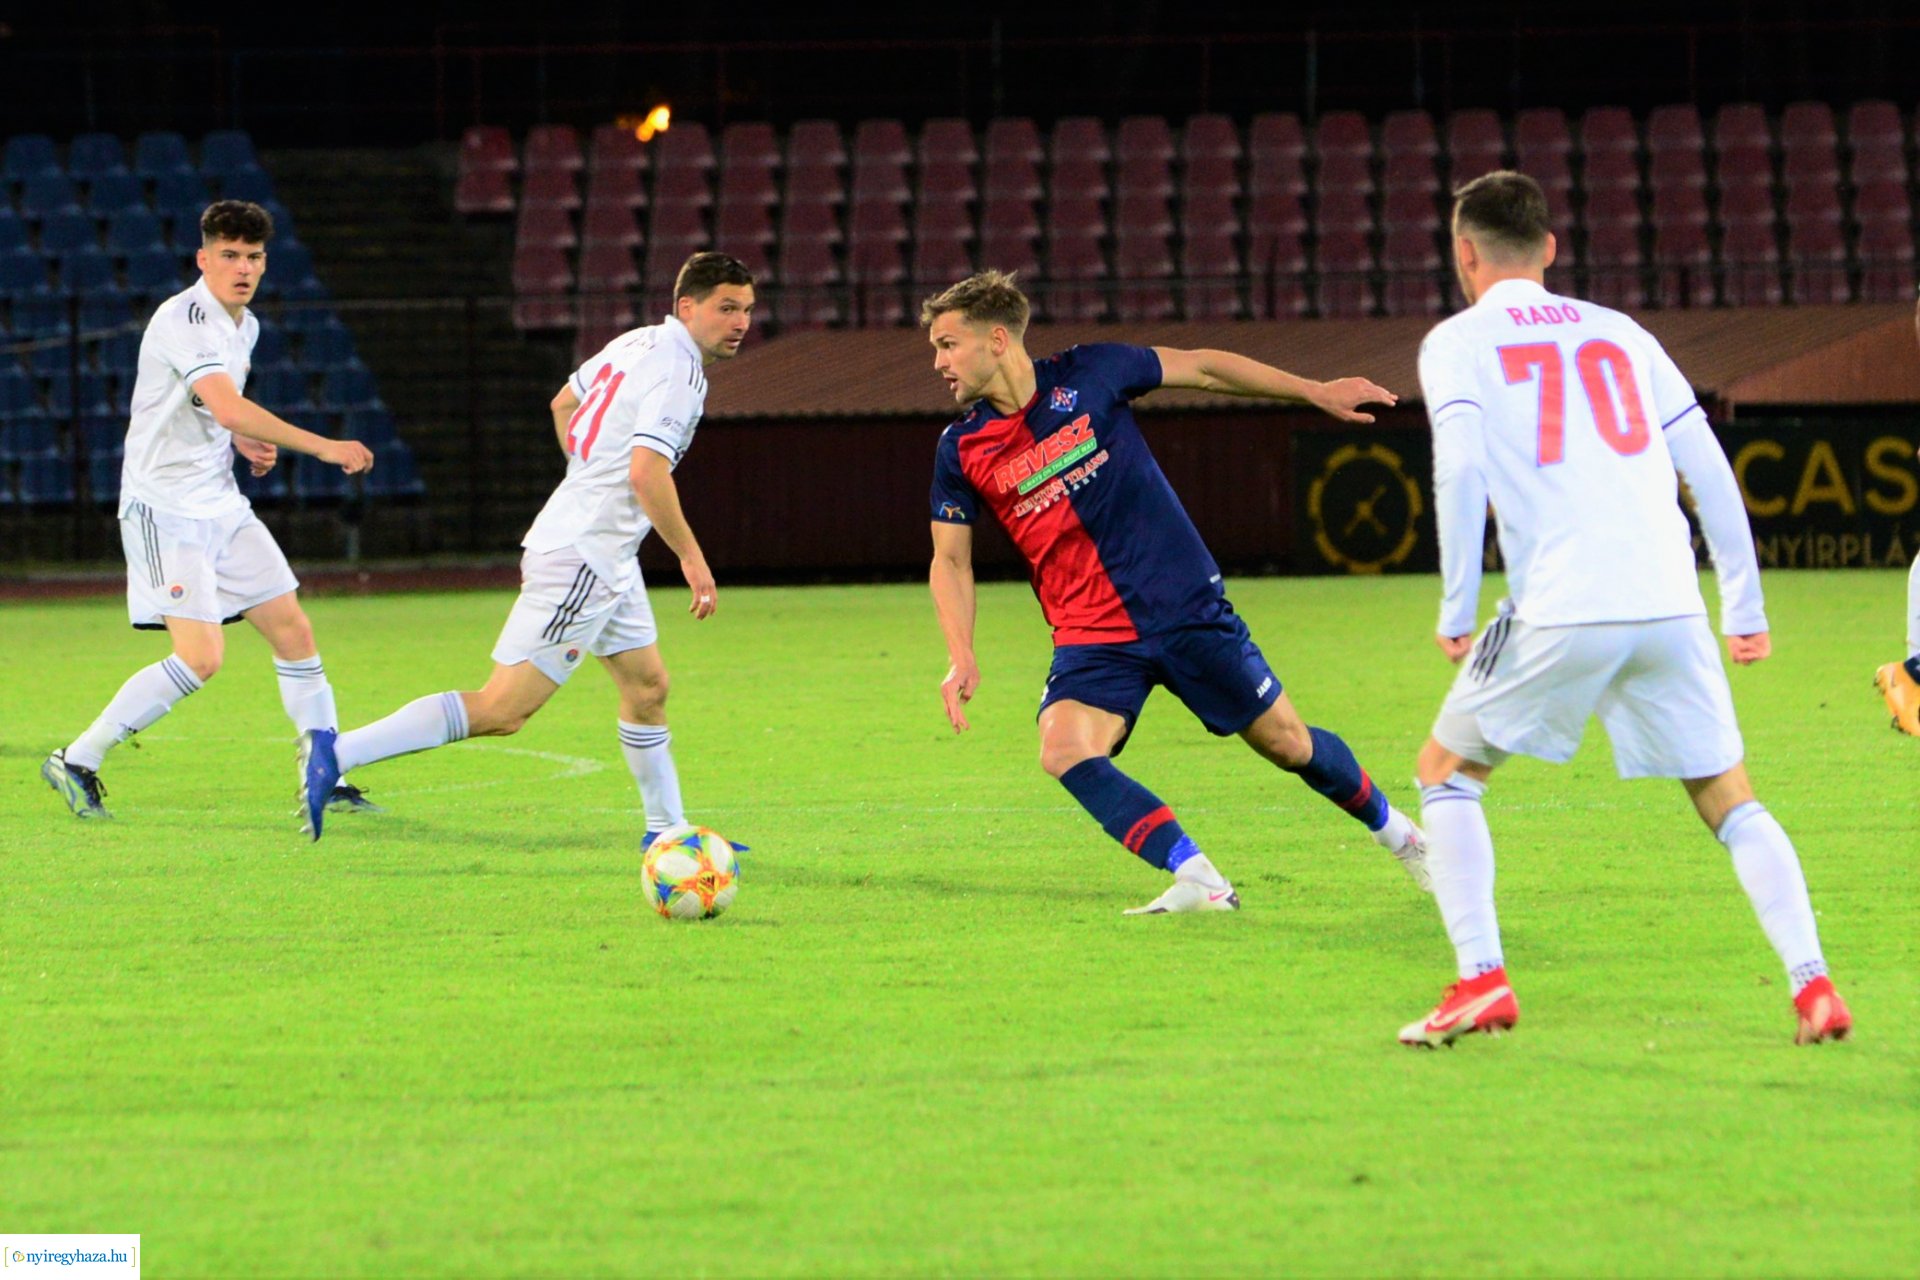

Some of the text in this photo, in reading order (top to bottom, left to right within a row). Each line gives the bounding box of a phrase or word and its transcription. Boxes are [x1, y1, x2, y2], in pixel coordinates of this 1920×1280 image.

[567, 362, 626, 463] 21
[1496, 338, 1651, 467] 70
[994, 413, 1095, 493] REVESZ
[1064, 449, 1109, 485] TRANS
[1757, 521, 1920, 569] NYÍRPLÁ
